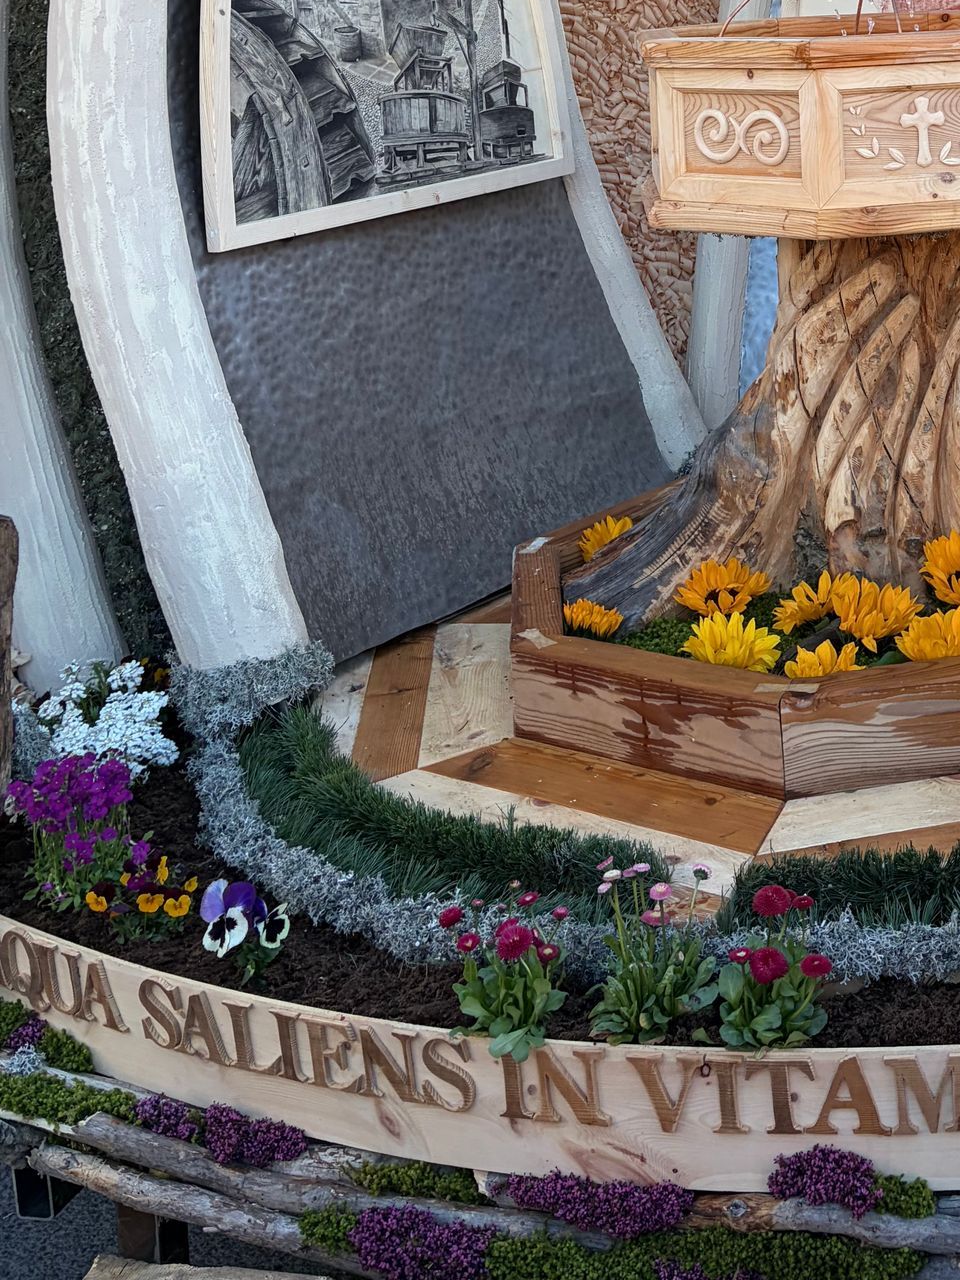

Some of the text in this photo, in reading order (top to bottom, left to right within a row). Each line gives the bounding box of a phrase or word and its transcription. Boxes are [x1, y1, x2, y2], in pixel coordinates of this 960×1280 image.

[0, 927, 130, 1033] QUA
[138, 976, 476, 1113] SALIENS
[500, 1048, 612, 1127] IN
